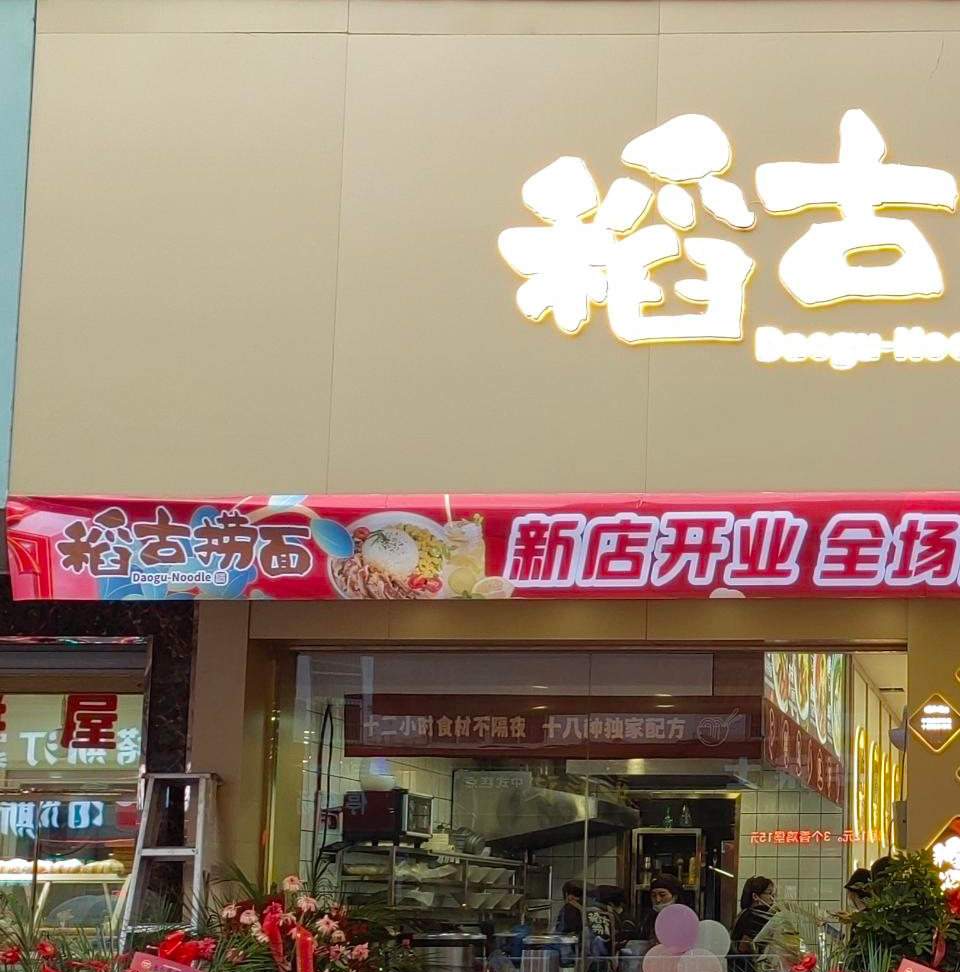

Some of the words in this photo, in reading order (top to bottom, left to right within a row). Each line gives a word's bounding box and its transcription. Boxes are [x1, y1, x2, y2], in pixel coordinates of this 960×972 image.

[56, 506, 313, 577] 稻古捞面
[132, 571, 212, 584] Daogu-Noodle
